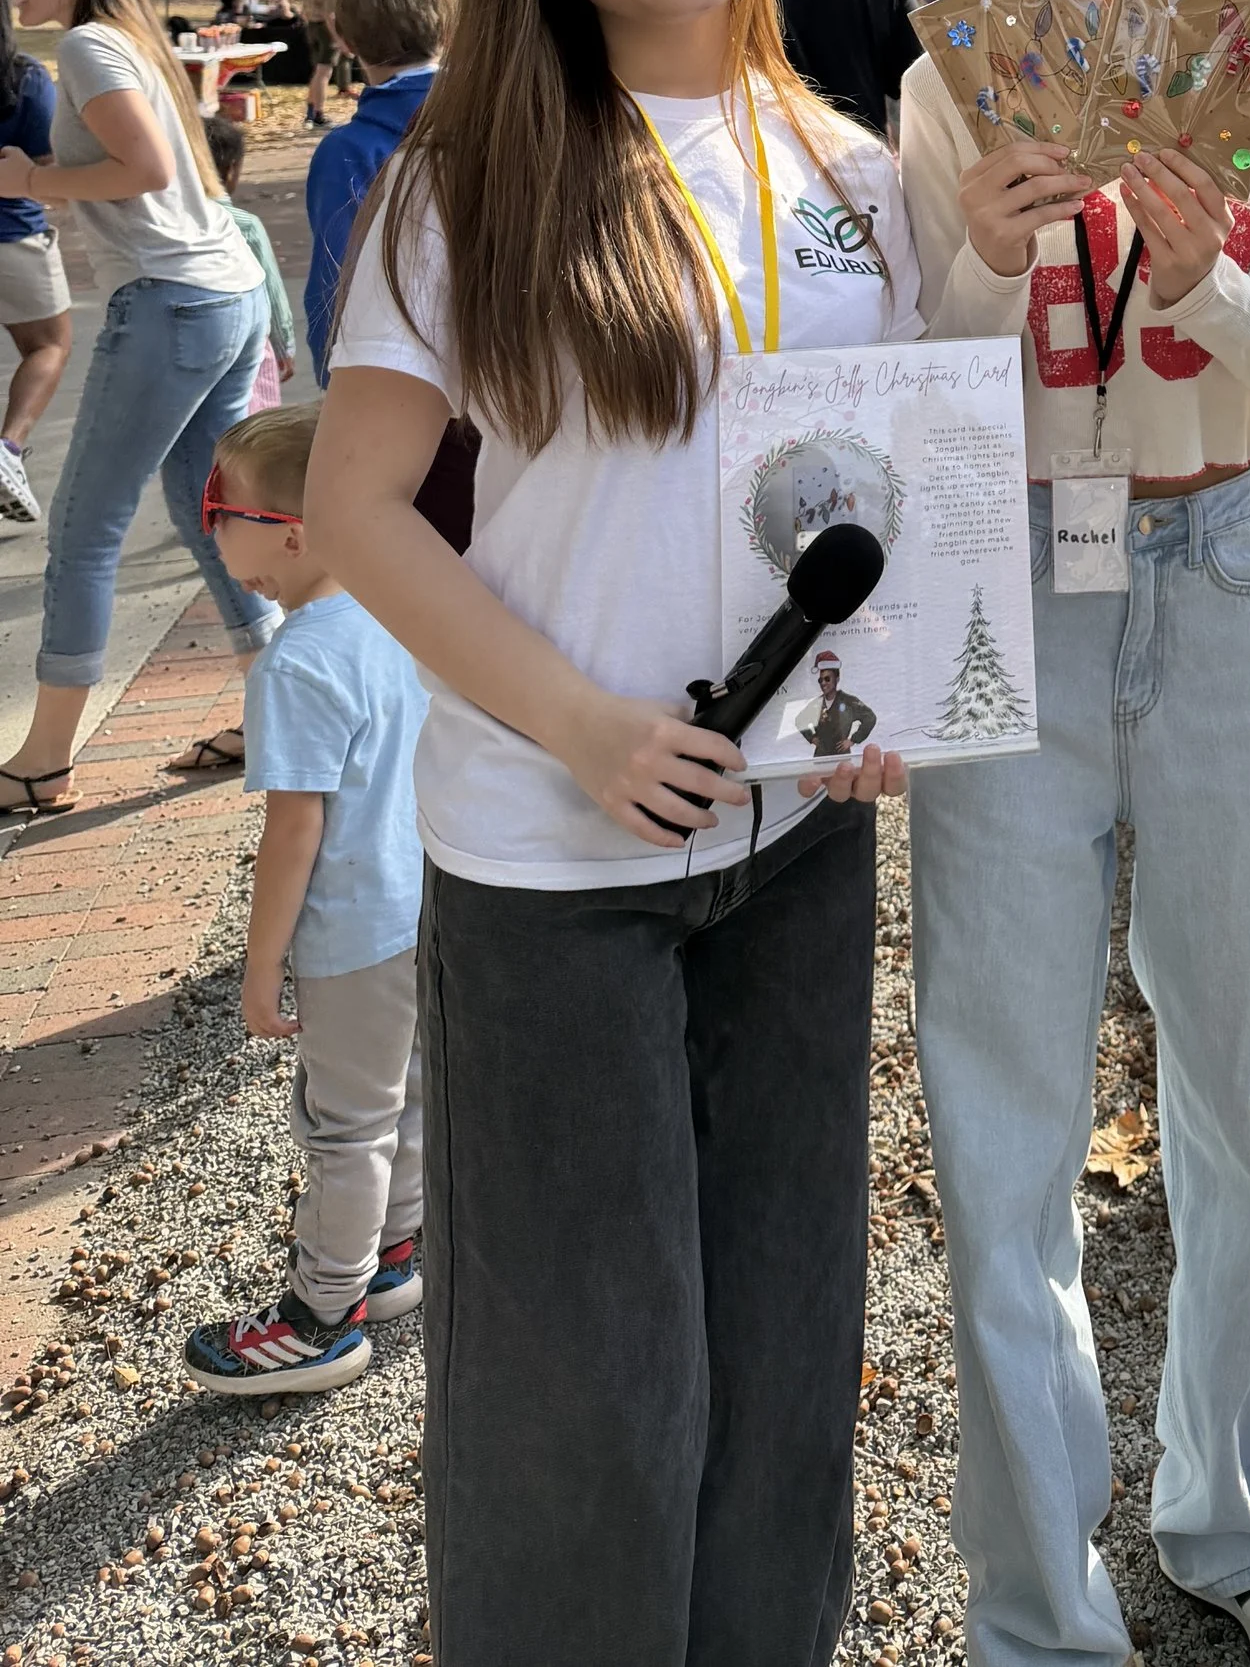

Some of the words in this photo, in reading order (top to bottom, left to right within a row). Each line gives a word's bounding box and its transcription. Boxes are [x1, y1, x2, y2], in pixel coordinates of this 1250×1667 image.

[795, 248, 884, 274] EDUBU
[736, 369, 818, 412] Jongbin's
[826, 365, 867, 407] Jolly
[875, 361, 962, 396] Christmas
[968, 356, 1012, 390] Card
[969, 433, 1012, 441] represents
[922, 455, 964, 463] Christmas
[920, 484, 944, 492] lights
[924, 503, 950, 511] giving
[941, 511, 970, 519] symbol
[931, 521, 973, 529] beginning
[939, 529, 985, 538] friendships
[1058, 528, 1115, 544] Rachel
[933, 539, 967, 548] Jongbin
[962, 546, 1000, 555] wherever
[868, 603, 900, 612] friends
[882, 614, 904, 622] time
[840, 627, 859, 635] with
